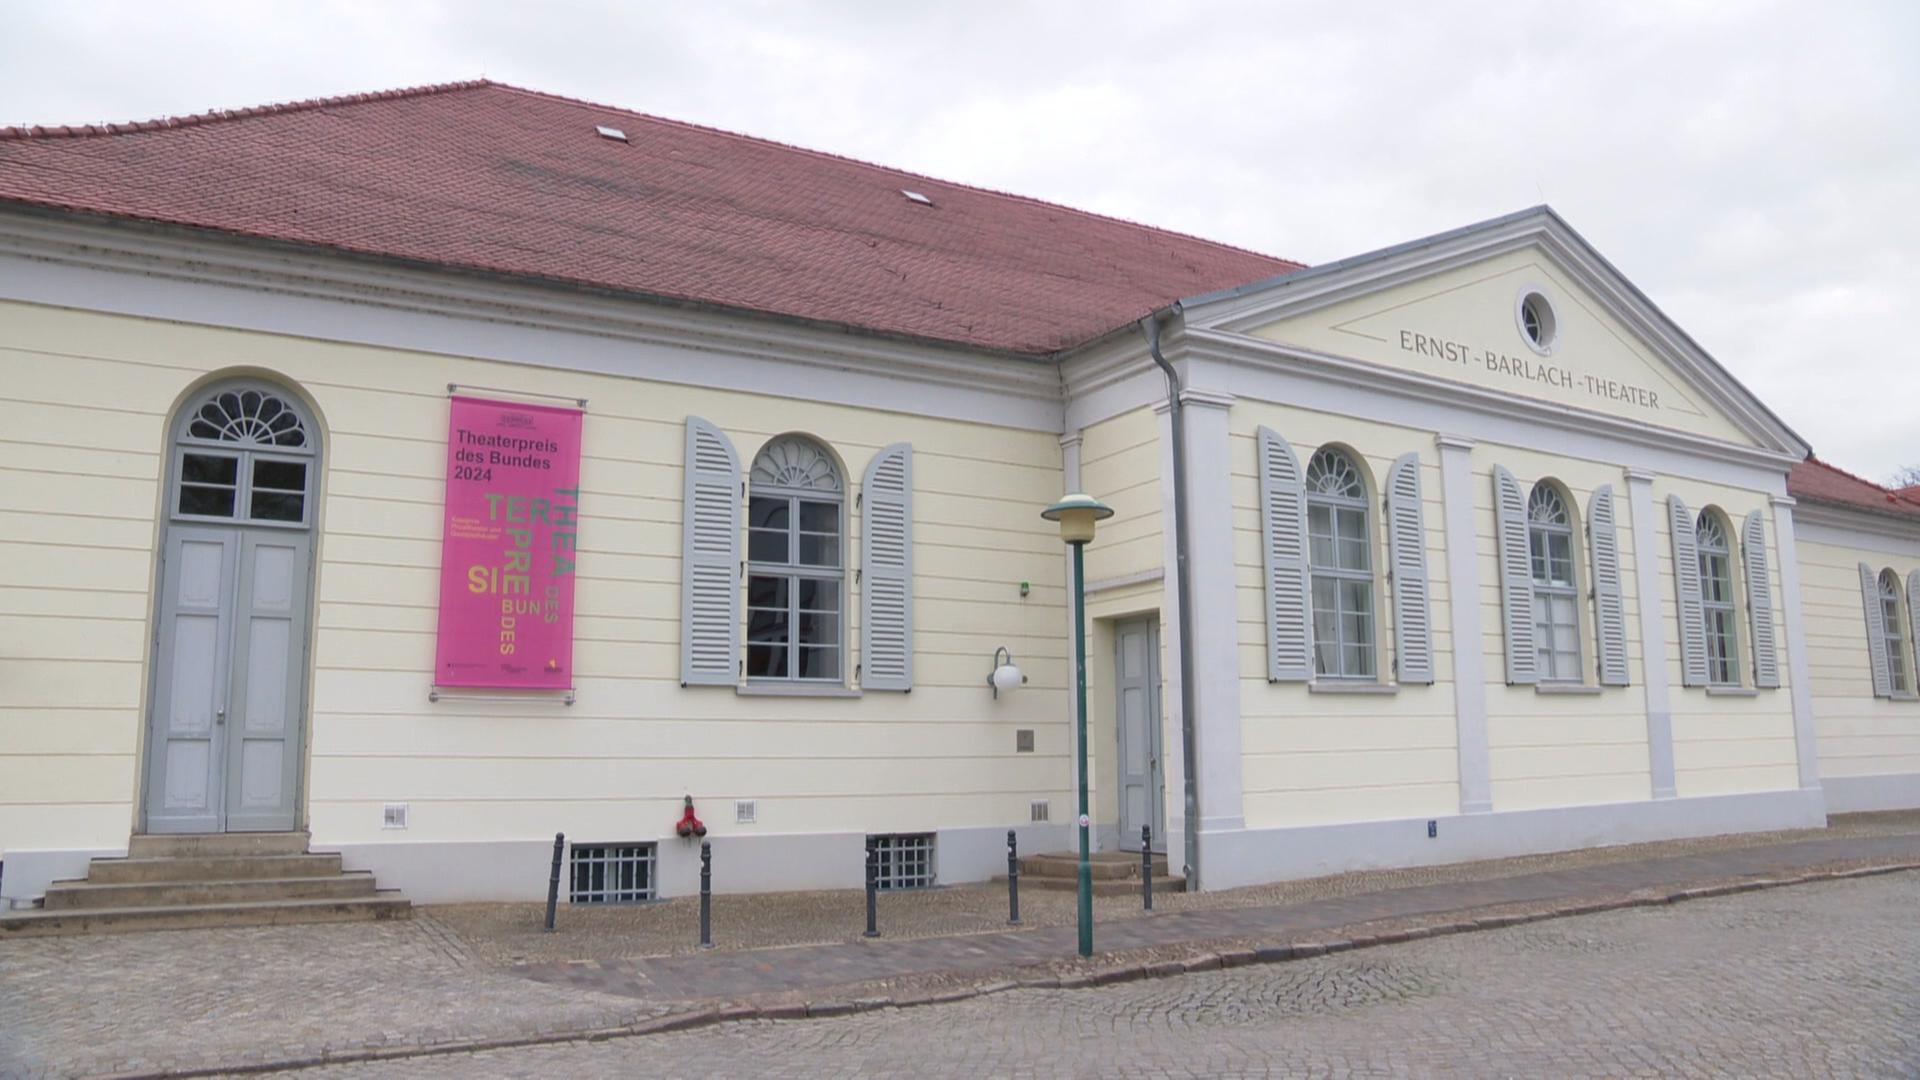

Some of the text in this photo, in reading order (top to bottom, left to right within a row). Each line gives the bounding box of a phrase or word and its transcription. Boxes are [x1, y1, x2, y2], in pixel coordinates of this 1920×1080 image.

[1400, 330, 1470, 364] ERNST
[1486, 351, 1573, 389] BARLACH
[456, 429, 558, 453] Theaterpreis
[455, 448, 551, 469] des Bundes
[454, 466, 492, 481] 2024
[502, 600, 541, 615] BUN
[500, 618, 516, 655] DES
